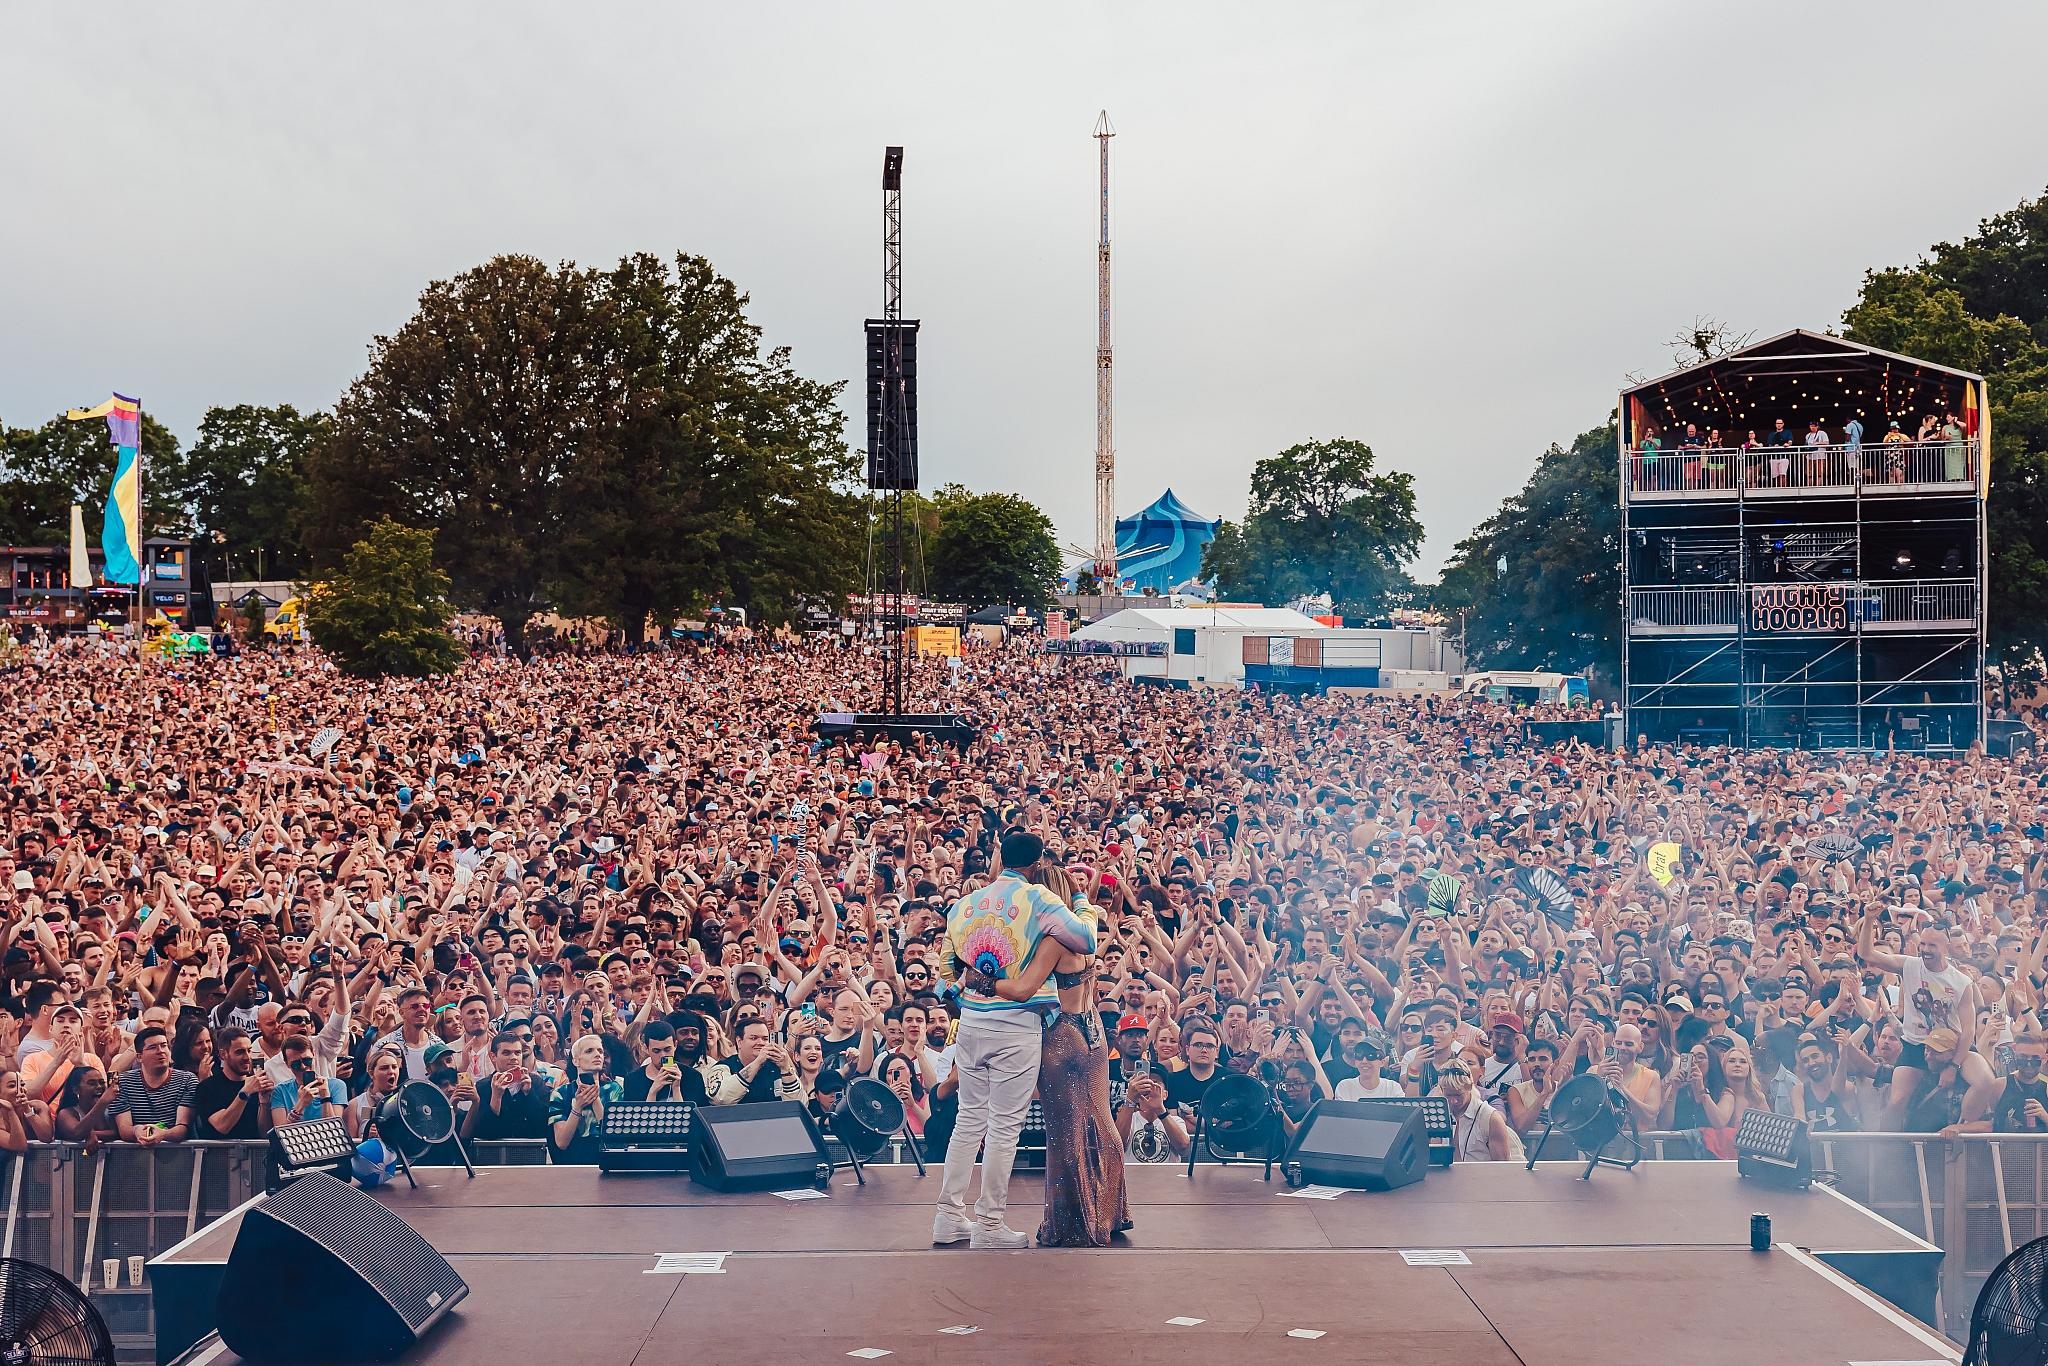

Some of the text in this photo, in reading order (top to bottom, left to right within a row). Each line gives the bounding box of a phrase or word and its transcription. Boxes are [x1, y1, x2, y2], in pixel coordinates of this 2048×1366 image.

[1752, 585, 1846, 607] MIGHTY
[1752, 607, 1846, 630] HOOPLA
[1652, 851, 1666, 874] brat
[231, 1015, 257, 1030] ATLAN
